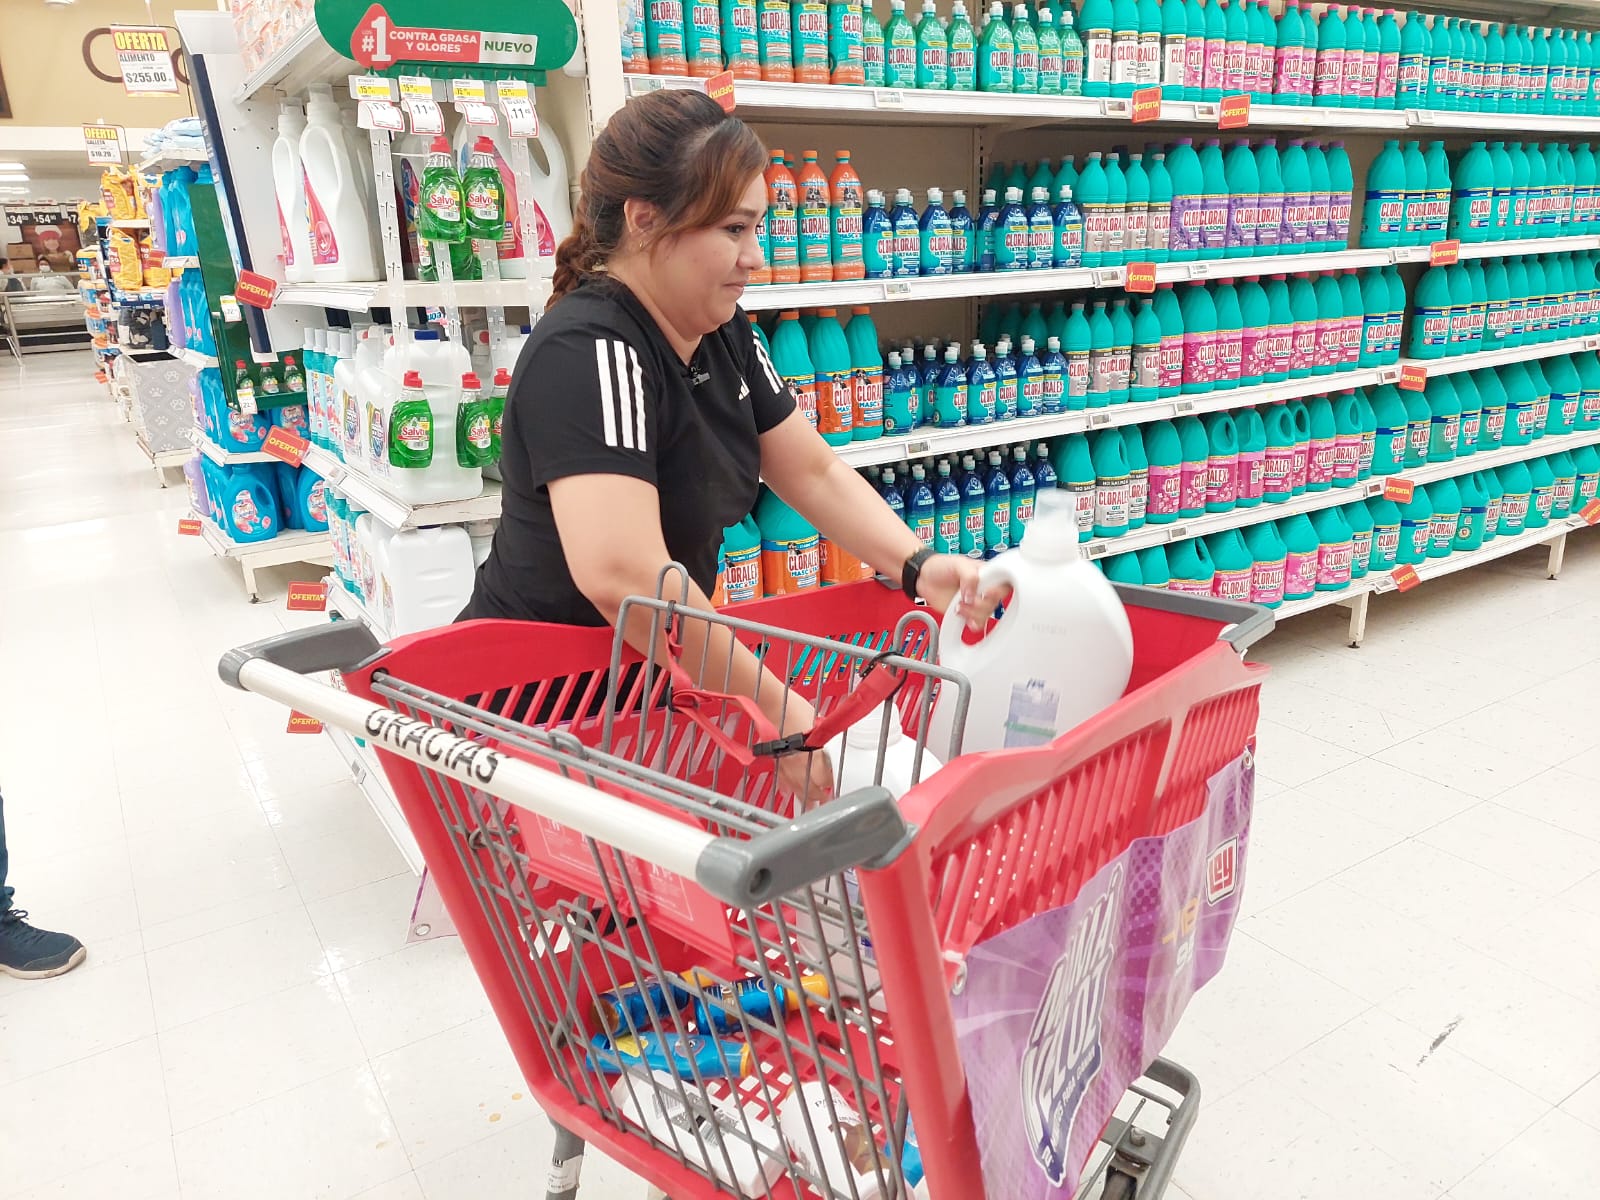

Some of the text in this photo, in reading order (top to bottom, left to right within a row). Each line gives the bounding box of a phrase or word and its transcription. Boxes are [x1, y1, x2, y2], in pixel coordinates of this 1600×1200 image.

[114, 31, 169, 51] OFERTA
[389, 30, 478, 44] CONTRA GRASA
[406, 42, 462, 53] Y OLORES
[484, 41, 533, 54] NUEVO
[1138, 46, 1159, 62] RALEX
[119, 53, 156, 63] ALIMENTO
[126, 72, 168, 83] $255.00
[84, 127, 118, 140] OFERTA
[431, 194, 455, 206] Salvo
[469, 193, 493, 205] Salvo
[1308, 206, 1328, 221] CLORA
[1381, 203, 1402, 217] CLORA
[1471, 201, 1491, 214] CLORA
[1200, 209, 1227, 226] CLORAL
[1287, 208, 1307, 222] CLORA
[1103, 217, 1121, 231] CLORA
[1132, 273, 1154, 282] OFERTA
[240, 282, 269, 298] OFERTA
[1385, 324, 1401, 337] CLOR
[1425, 319, 1448, 331] CLORA
[1340, 330, 1361, 343] CLORA
[1219, 343, 1241, 358] CLORA
[1267, 338, 1291, 353] CLORA
[1161, 350, 1182, 365] CLORA
[1111, 358, 1131, 376] CLORA
[1404, 375, 1425, 383] OFERTA
[835, 390, 850, 406] CLOR
[857, 385, 882, 402] CLORAL
[268, 437, 299, 456] OFERTA
[1265, 459, 1291, 473] ORALEX
[1099, 490, 1128, 505] CLORAL
[1389, 487, 1410, 495] OFERTA
[1018, 506, 1033, 519] CLOR
[1430, 523, 1456, 536] CLORAL
[1379, 534, 1398, 547] CLORA
[789, 551, 819, 571] CLORALE
[1326, 553, 1350, 567] CLORAL
[726, 563, 757, 583] LORALE
[792, 567, 818, 577] MASCTA
[1253, 571, 1283, 585] CLORALE
[1221, 580, 1249, 595] CLORALE
[290, 592, 320, 601] OFERTA
[291, 717, 319, 726] OFERTA
[365, 708, 499, 784] GRACIAS
